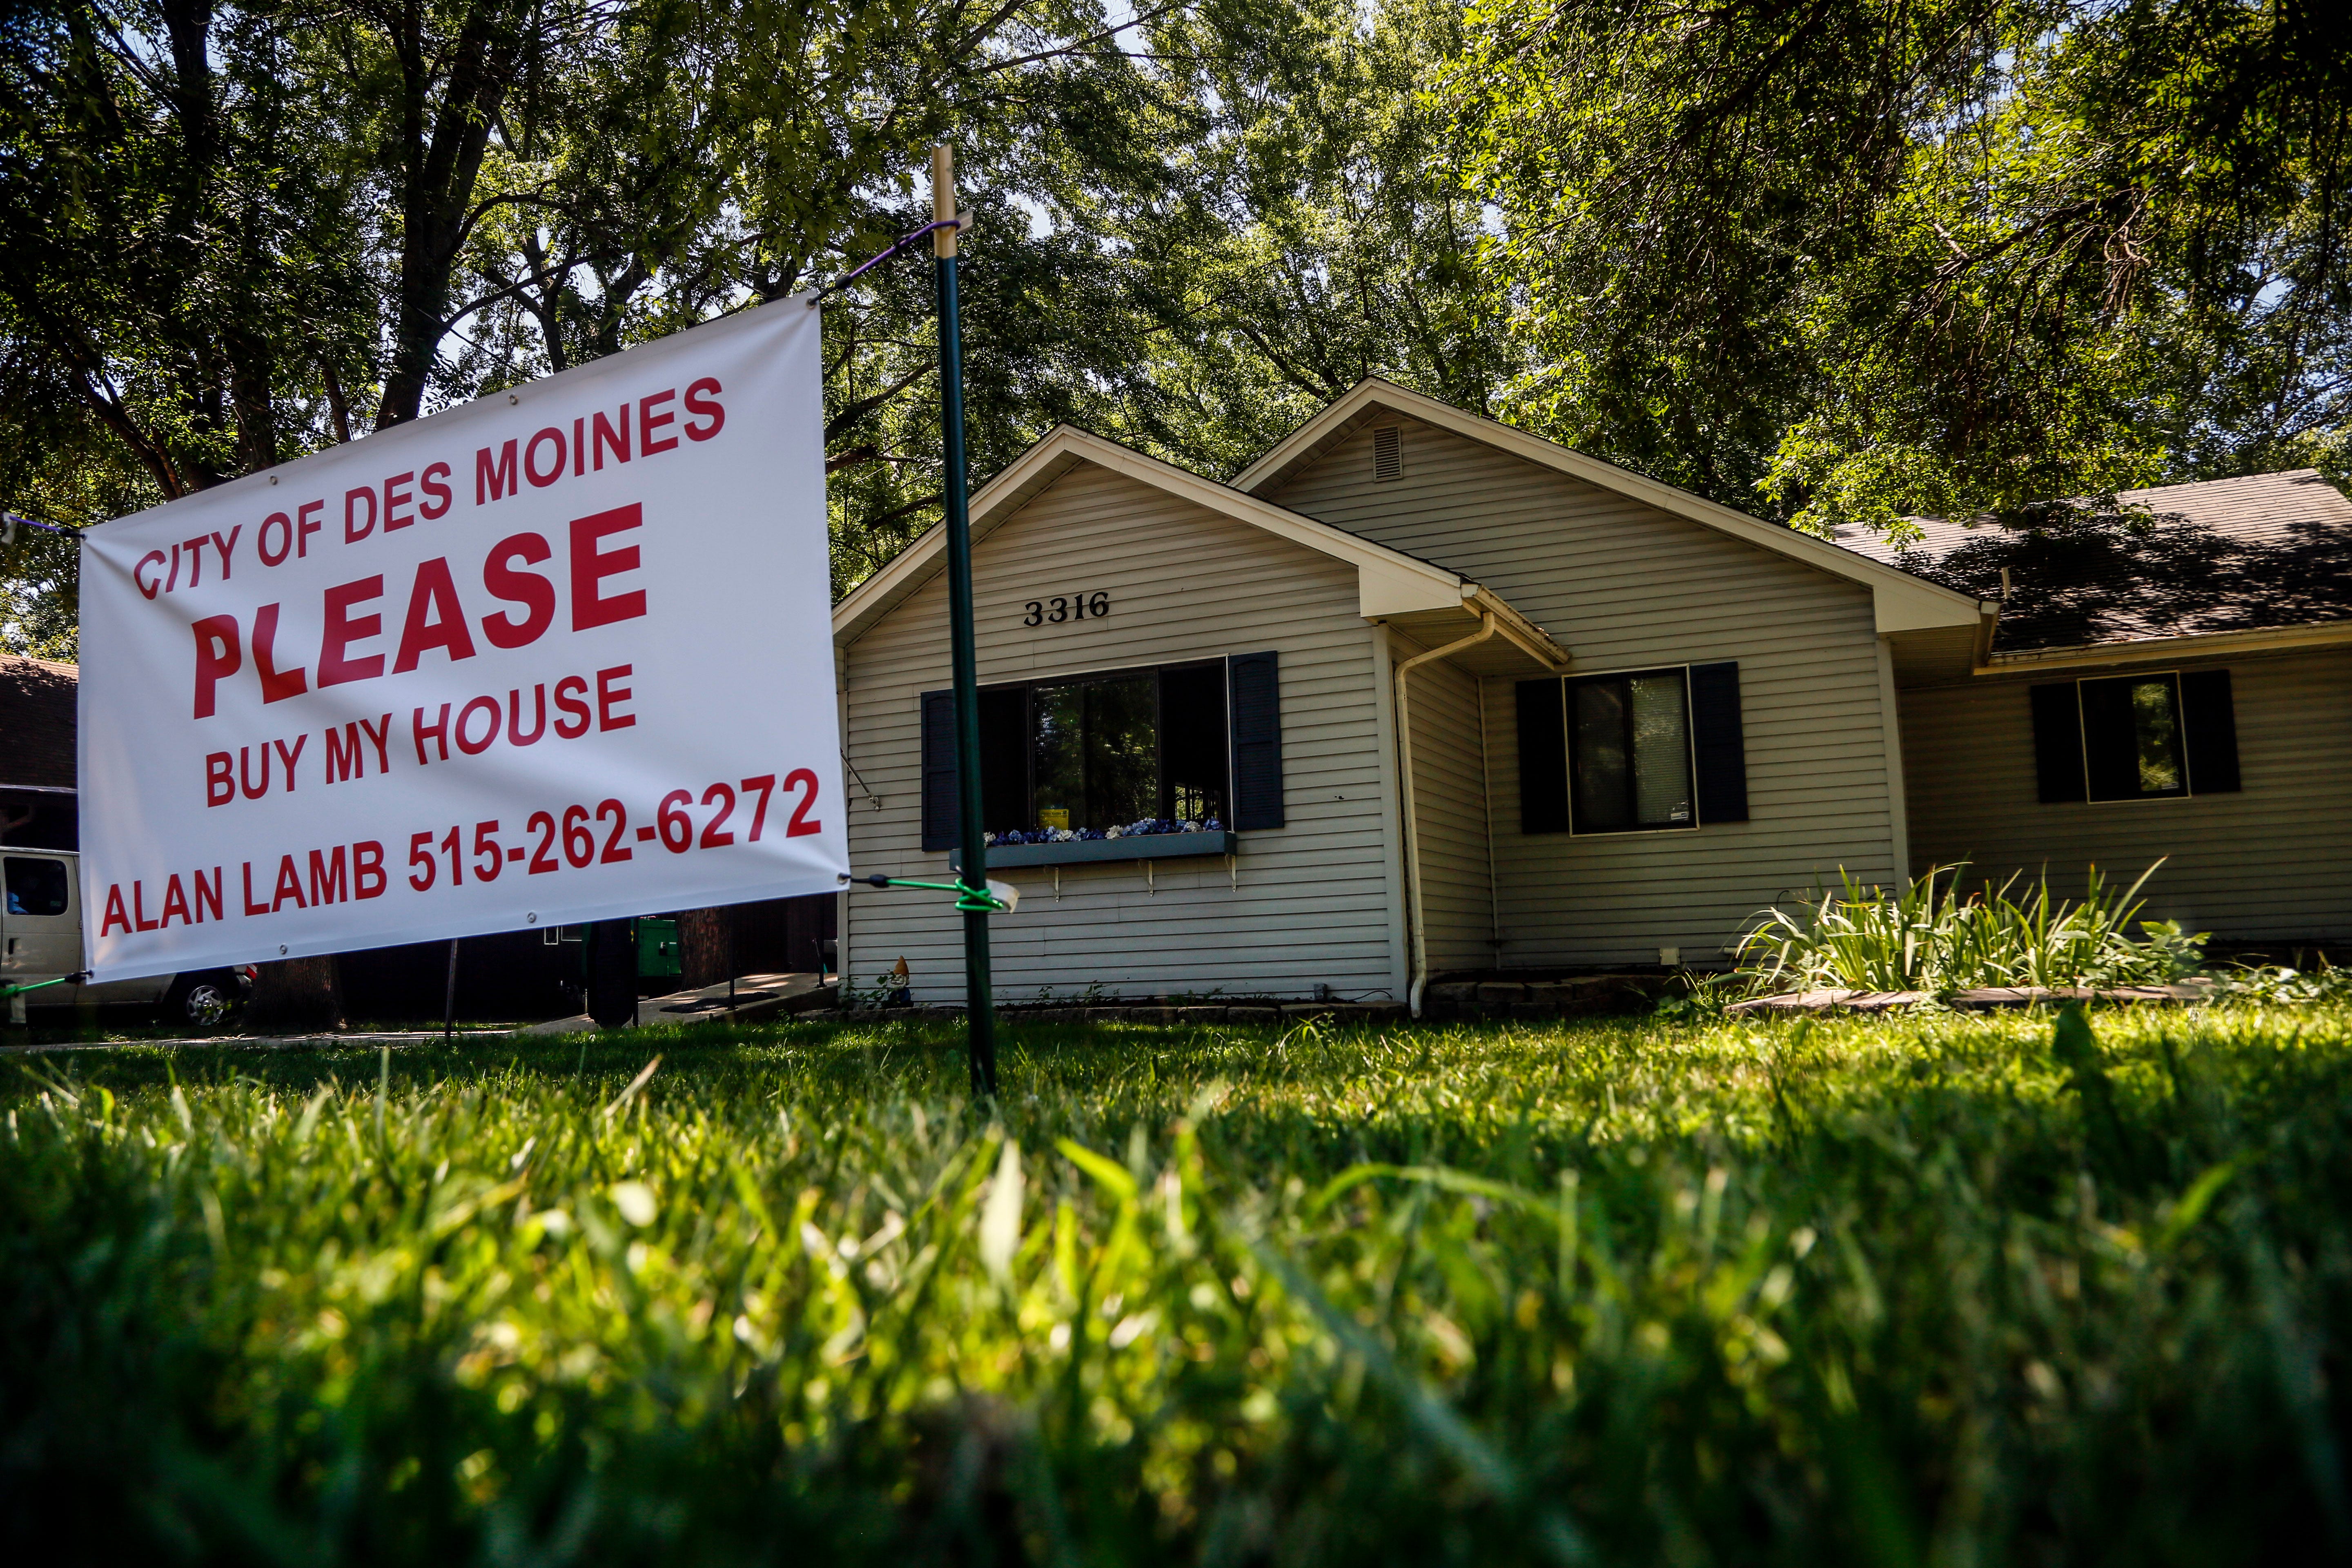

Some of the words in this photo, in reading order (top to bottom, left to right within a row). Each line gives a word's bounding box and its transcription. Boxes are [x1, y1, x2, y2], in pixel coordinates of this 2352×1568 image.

[134, 526, 240, 601] CITY
[258, 500, 324, 567] OF
[345, 463, 451, 544] DES
[477, 378, 725, 505] MOINES
[192, 502, 647, 719] PLEASE
[1024, 592, 1109, 626] 3316
[206, 735, 307, 808] BUY
[325, 713, 391, 784] MY
[413, 664, 636, 765] HOUSE
[100, 866, 223, 938] ALAN
[243, 841, 386, 916] LAMB
[409, 768, 822, 891] 515-262-6272
